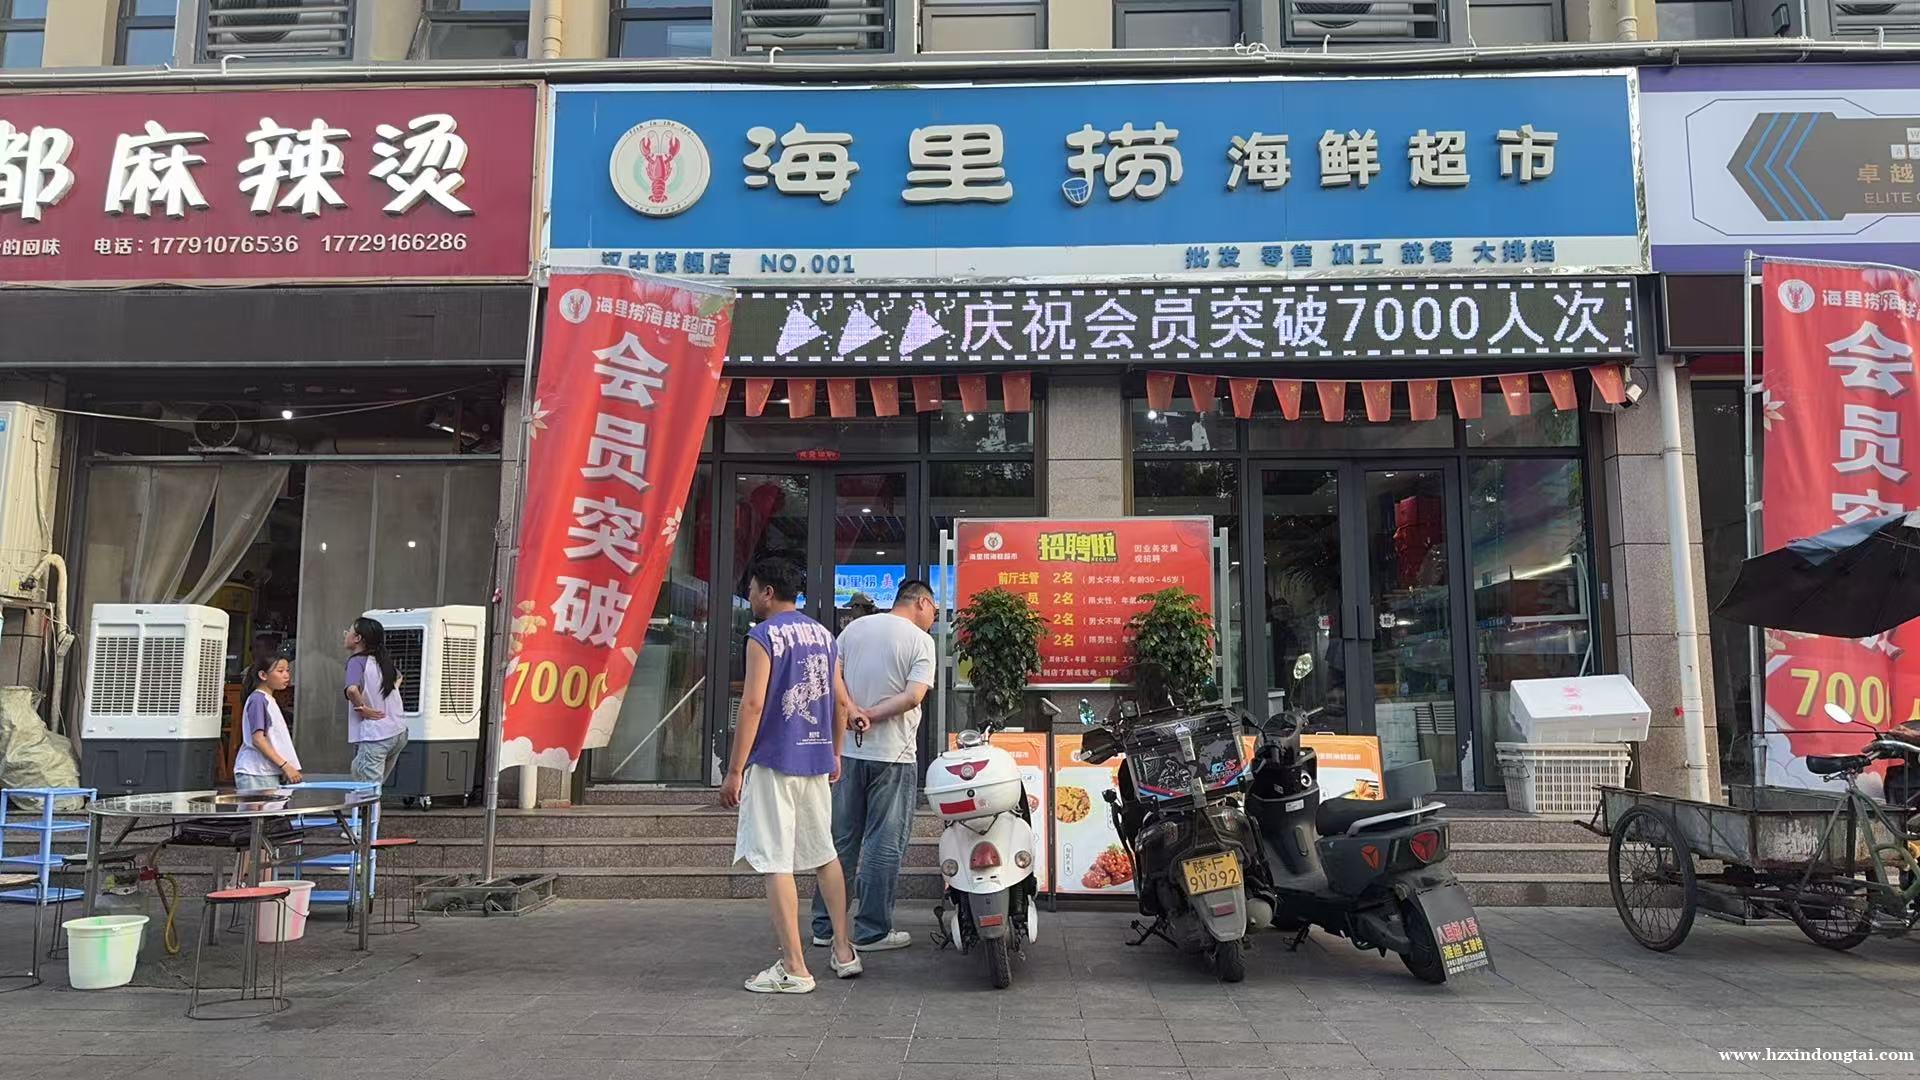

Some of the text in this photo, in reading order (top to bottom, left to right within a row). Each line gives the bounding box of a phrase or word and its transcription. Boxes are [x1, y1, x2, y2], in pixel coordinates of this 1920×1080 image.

[743, 121, 1559, 205] 海里捞 海鲜超市
[1864, 192, 1912, 204] ELITE
[0, 238, 61, 256] 的回味
[321, 232, 467, 252] 17729166286
[1185, 239, 1556, 269] 批发 零售 加工 就餐 大排档
[601, 250, 856, 275] 汉中旗舰店 NO.001
[595, 296, 717, 336] 海里捞海鲜超市
[961, 290, 1610, 352] 庆祝会员突破7000人次
[550, 331, 669, 648] 会员突破
[1038, 532, 1117, 563] 招聘啦
[998, 571, 1040, 585] 前厅主管
[1052, 571, 1073, 585] 2名
[1053, 592, 1074, 605] 2名
[1053, 613, 1074, 626] 2名
[1054, 633, 1074, 647] 2名
[1790, 668, 1892, 728] 700
[1190, 867, 1240, 892] 9V992
